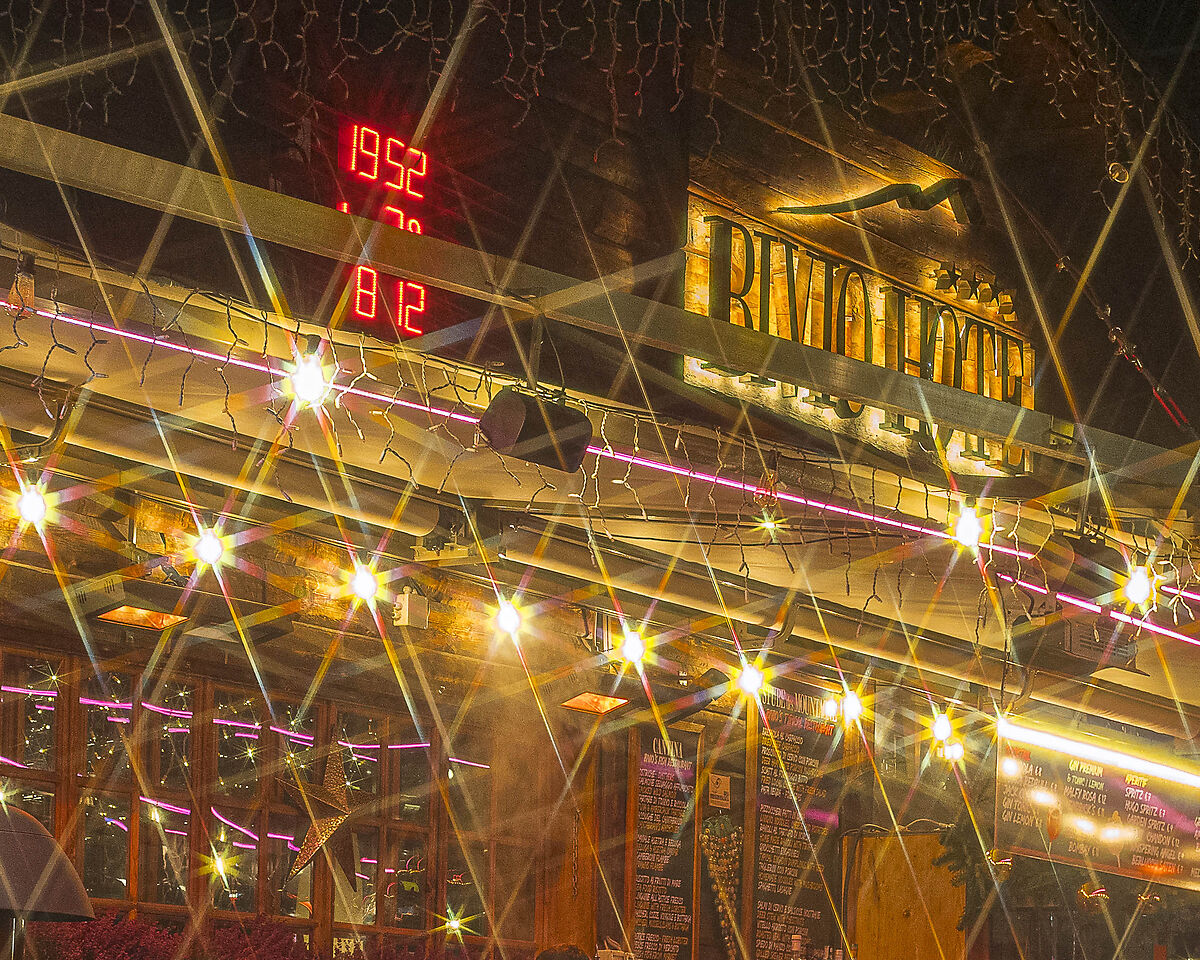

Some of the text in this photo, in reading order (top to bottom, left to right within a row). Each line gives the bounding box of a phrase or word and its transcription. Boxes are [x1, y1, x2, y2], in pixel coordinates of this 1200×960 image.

[397, 279, 426, 336] 12
[1125, 774, 1148, 788] APERITIF
[1125, 787, 1152, 802] SPRITZ €7
[1125, 800, 1166, 818] HUGO SPRITZ €7
[1148, 819, 1166, 832] SPRITZ
